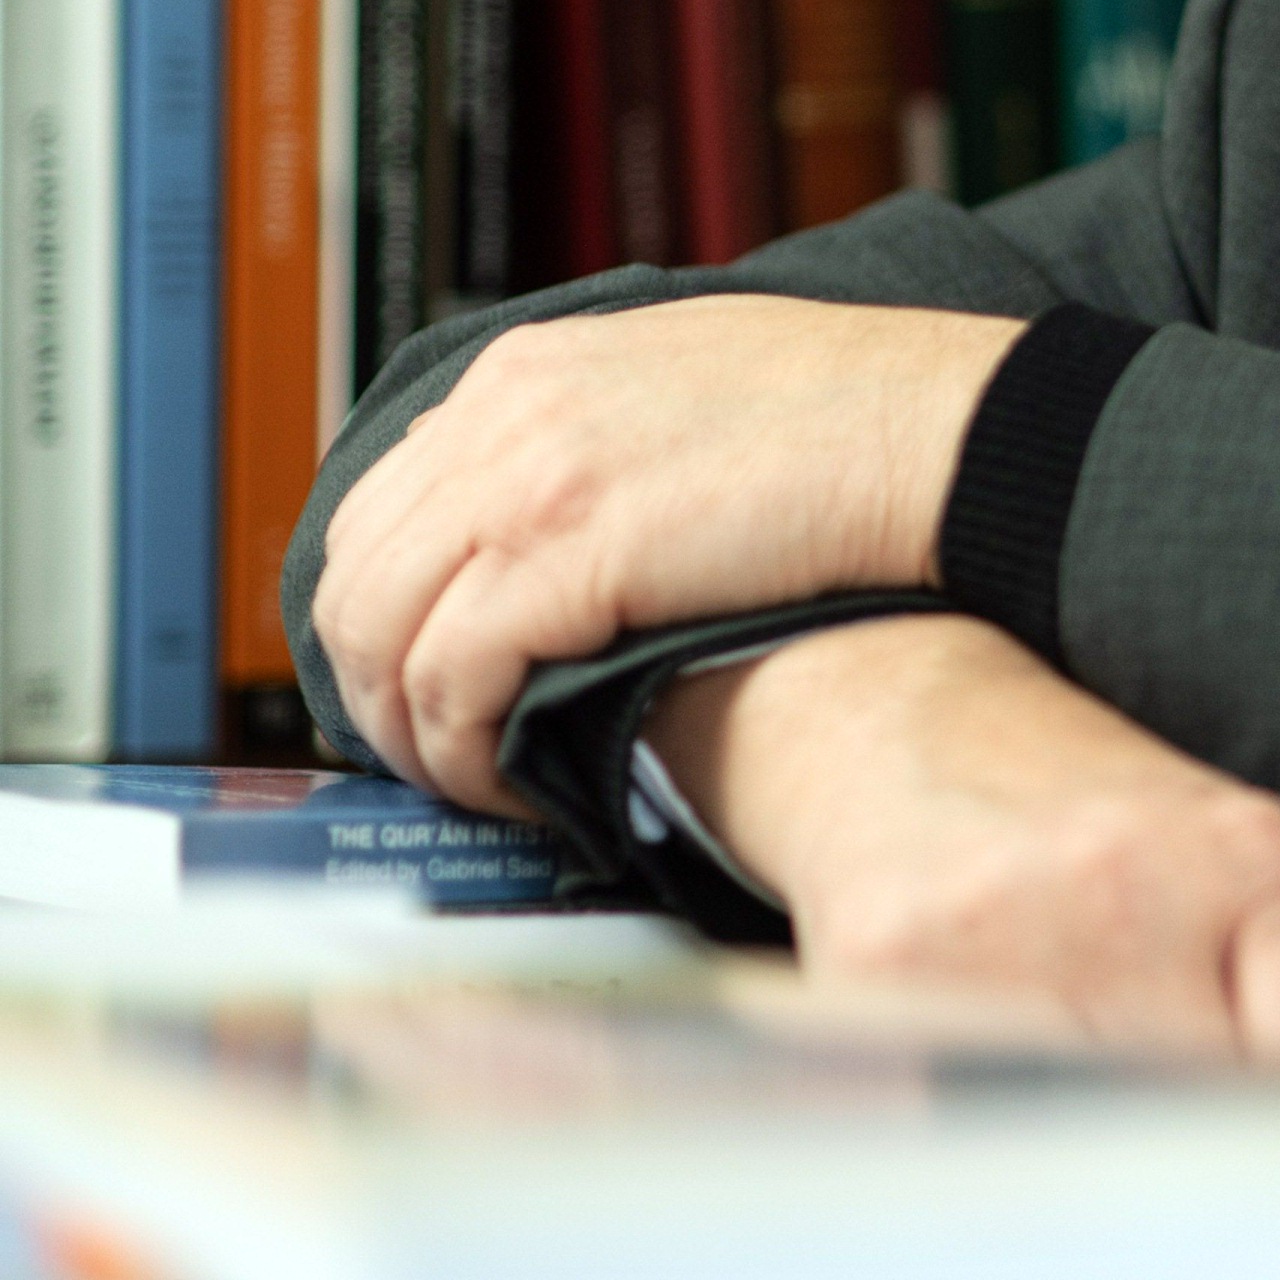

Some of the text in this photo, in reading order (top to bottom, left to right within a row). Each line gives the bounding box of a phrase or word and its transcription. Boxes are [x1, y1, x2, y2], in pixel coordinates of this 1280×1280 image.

[328, 823, 374, 850] THE
[476, 822, 499, 847] IN
[327, 857, 391, 882] Edited
[397, 858, 420, 888] by
[426, 854, 501, 880] Gabriel
